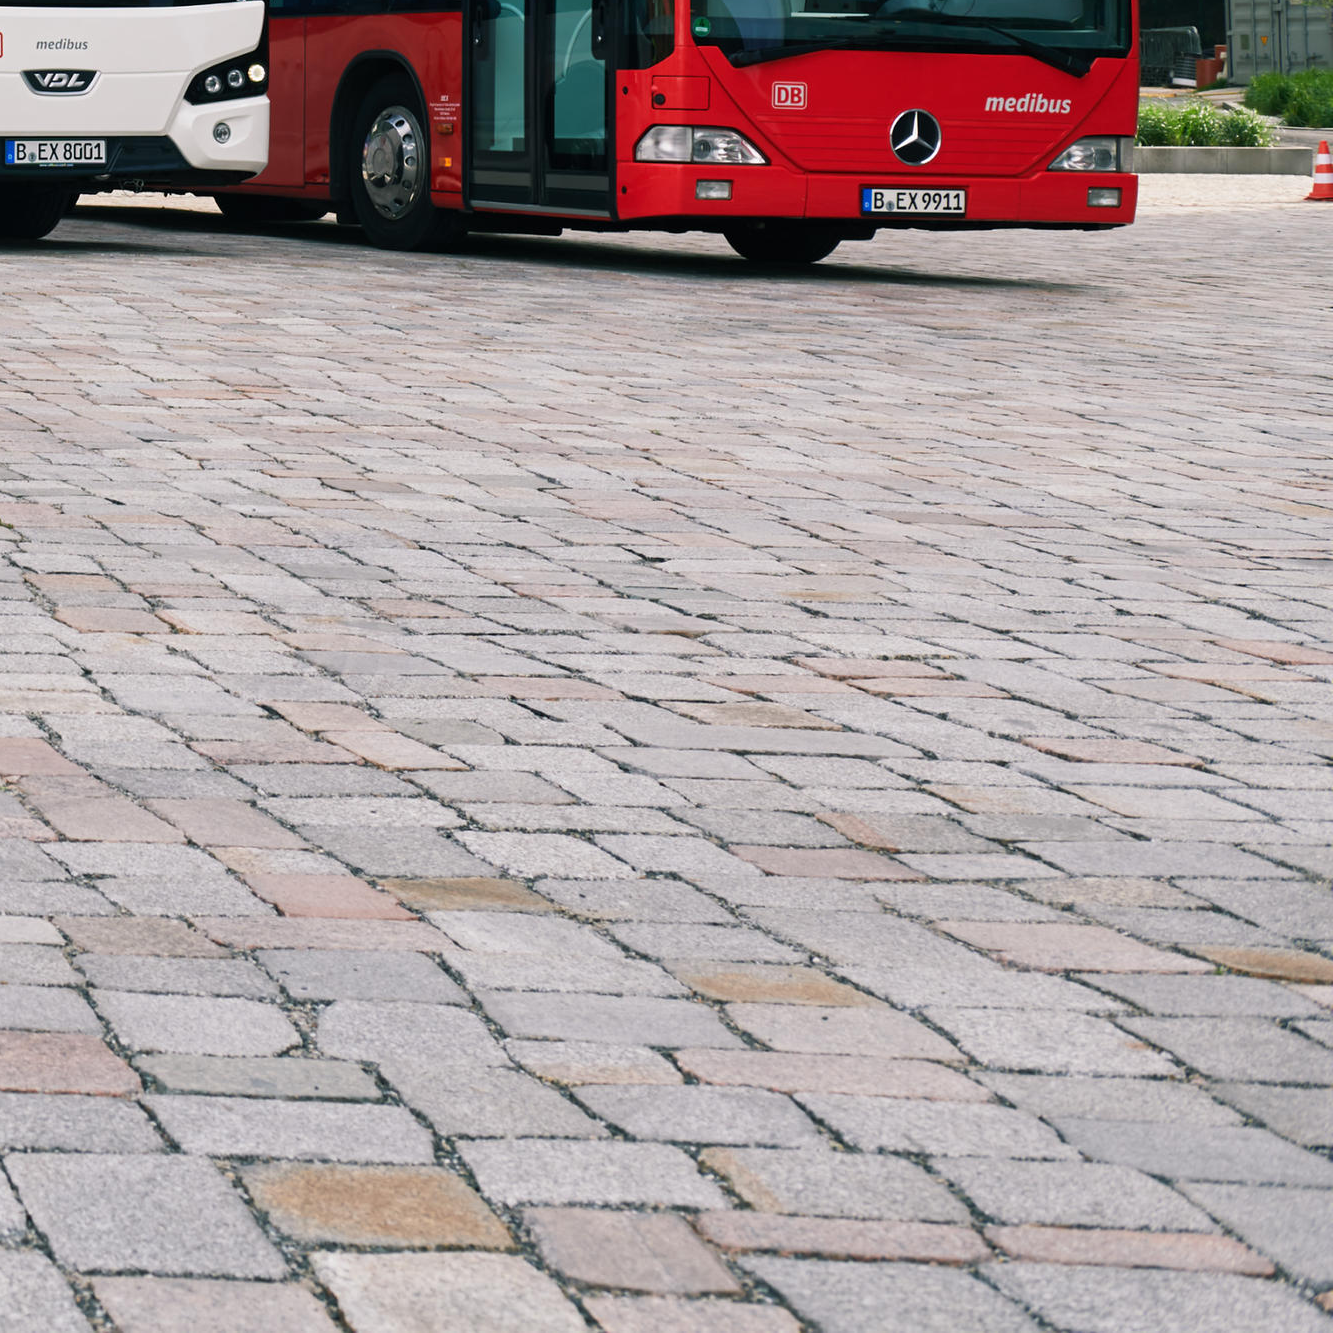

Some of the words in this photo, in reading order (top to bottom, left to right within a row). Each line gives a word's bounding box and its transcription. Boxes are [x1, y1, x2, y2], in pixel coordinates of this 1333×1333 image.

[36, 38, 89, 50] medibus
[33, 73, 85, 88] VDL
[985, 93, 1072, 115] medibus
[16, 143, 27, 161] B
[38, 143, 59, 161] EX
[63, 142, 103, 161] 8001
[874, 191, 885, 210] B
[896, 192, 918, 210] EX
[922, 192, 963, 210] 9911
